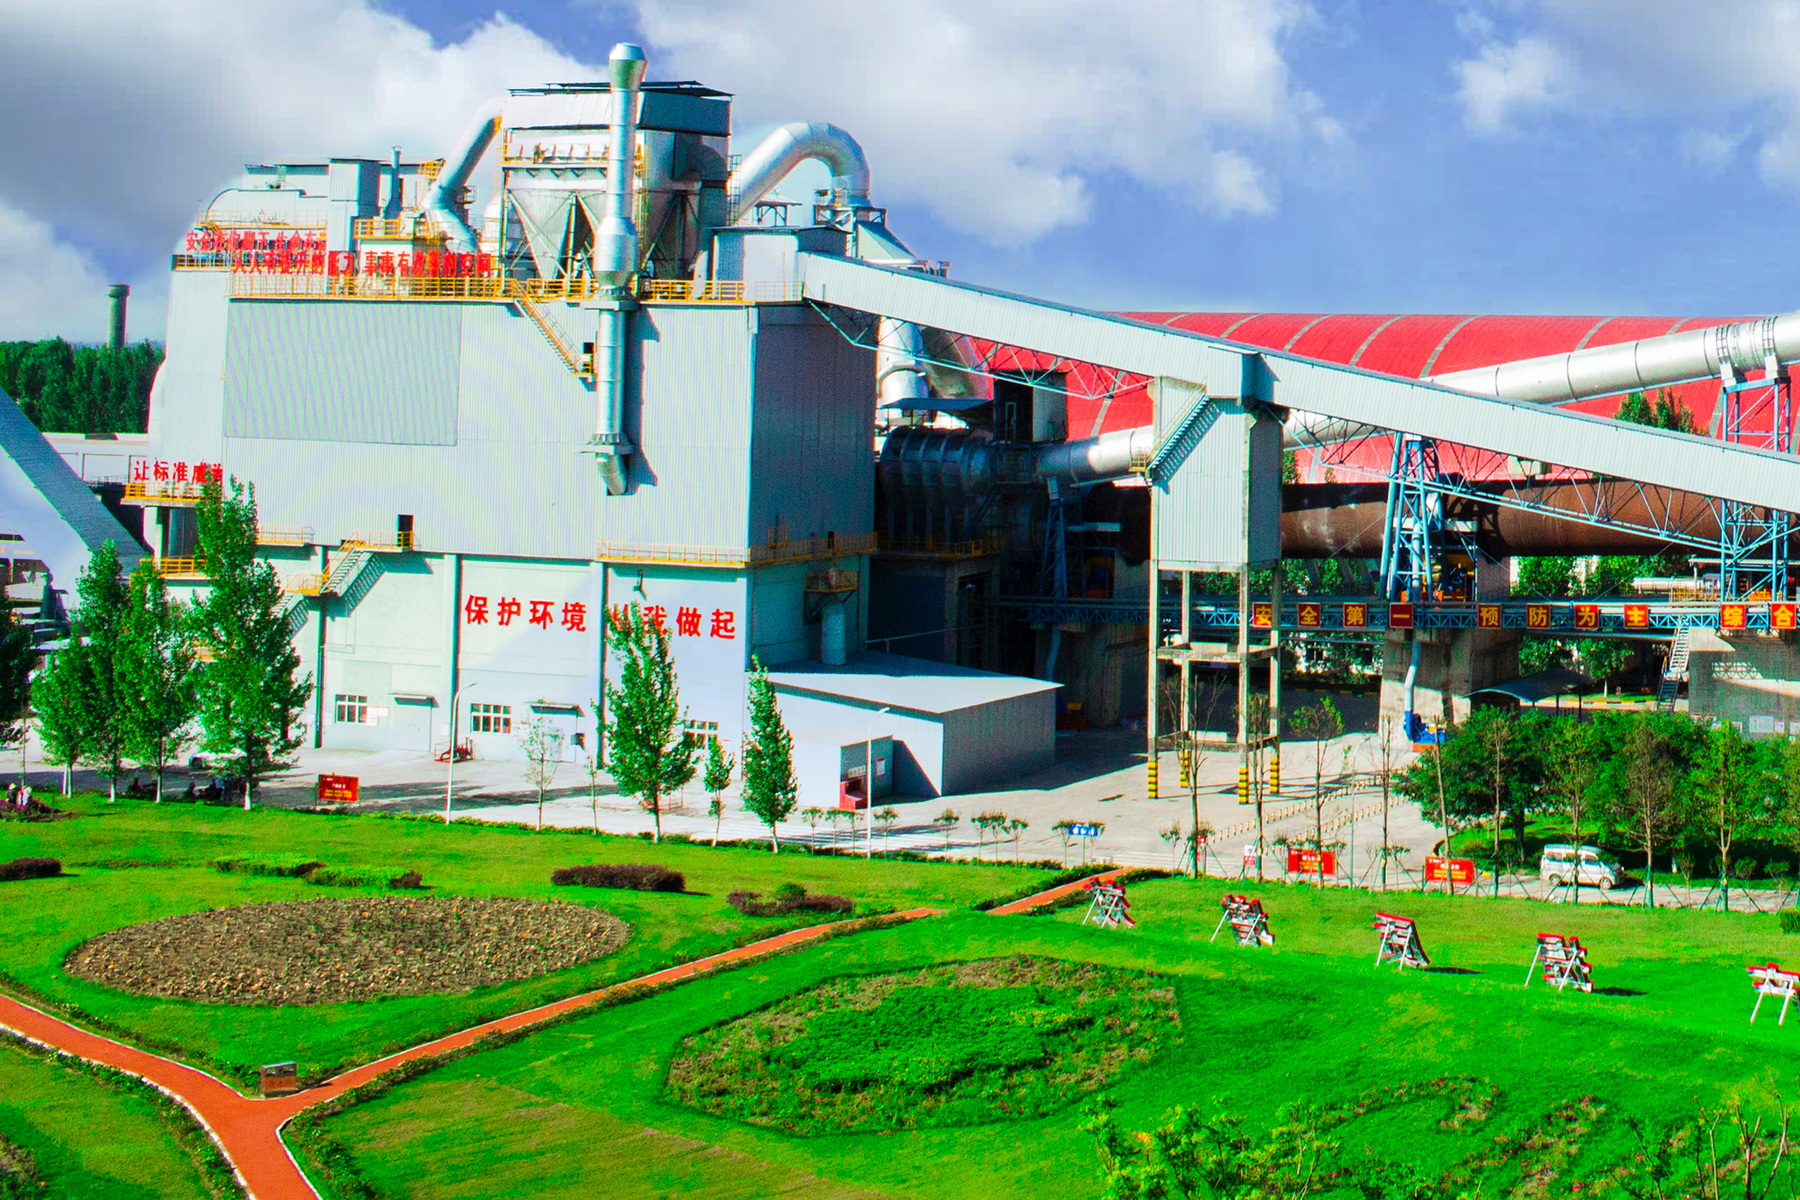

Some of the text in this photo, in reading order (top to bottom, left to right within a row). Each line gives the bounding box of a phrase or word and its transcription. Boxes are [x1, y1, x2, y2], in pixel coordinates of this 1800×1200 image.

[465, 595, 587, 632] 保护环境
[1256, 606, 1410, 626] 安全第一
[1480, 606, 1646, 627] 预防为主
